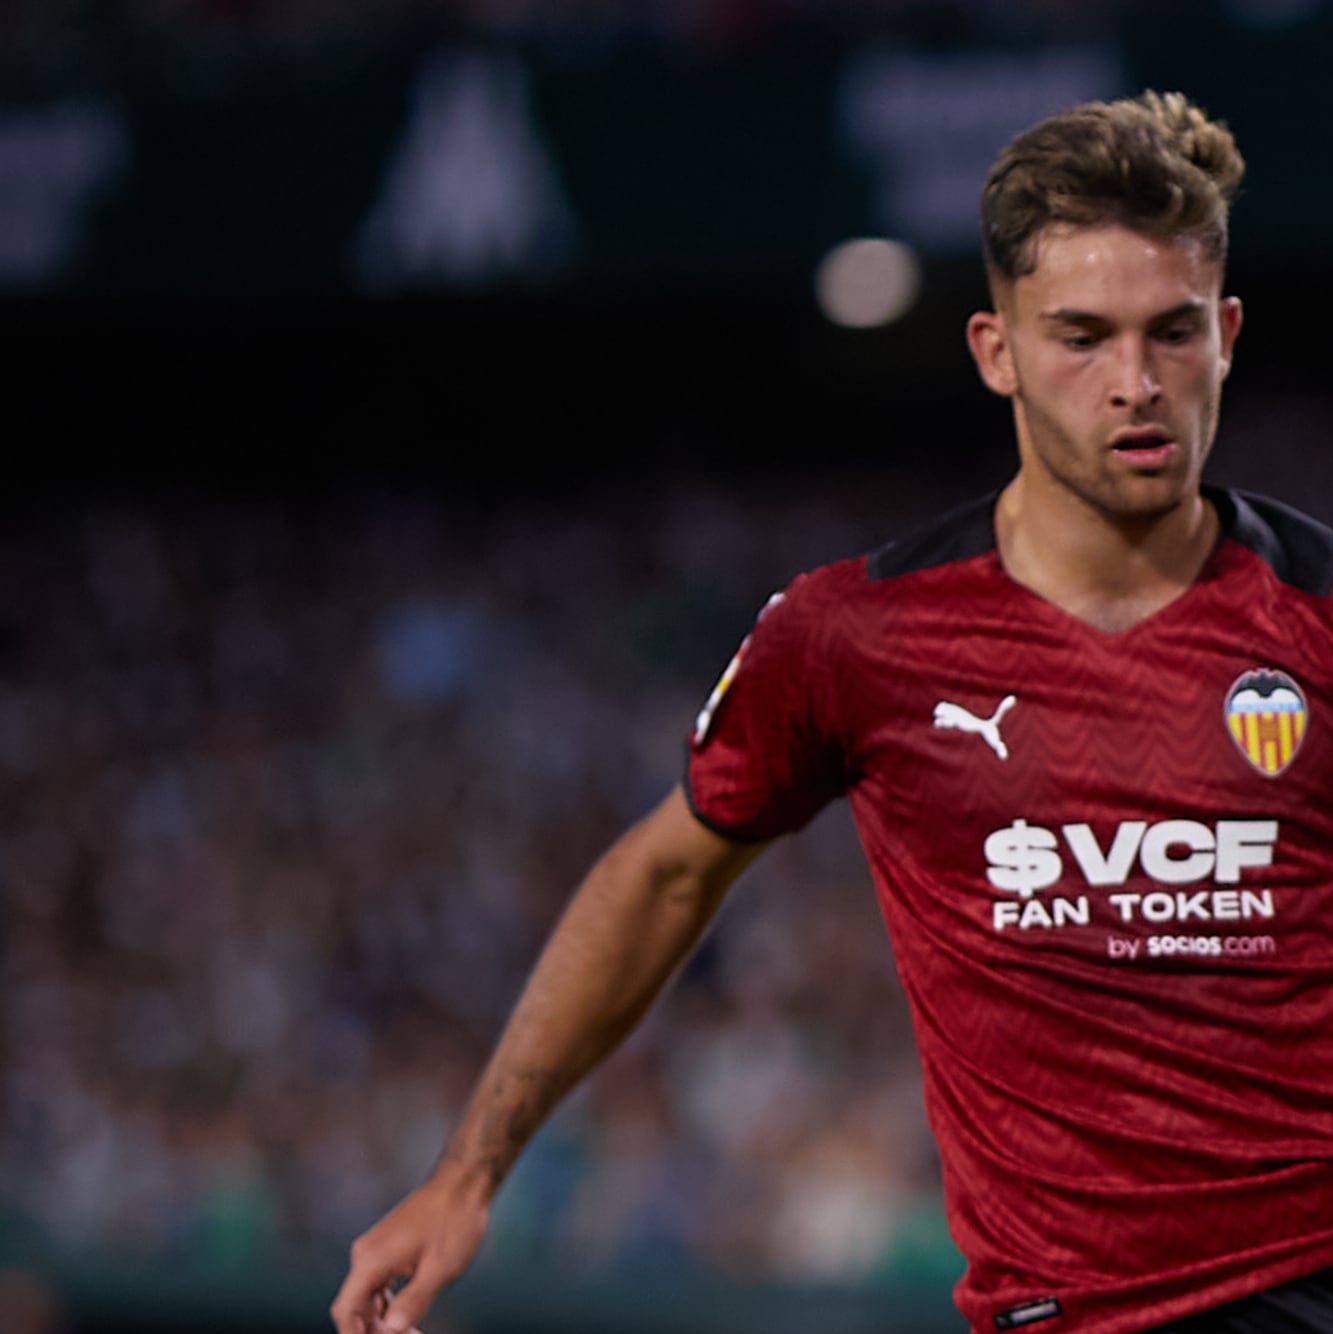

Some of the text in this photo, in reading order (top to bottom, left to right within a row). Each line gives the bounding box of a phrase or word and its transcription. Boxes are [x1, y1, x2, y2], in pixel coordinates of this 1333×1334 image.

[984, 819, 1278, 898] $VCF
[993, 889, 1275, 931] FAN TOKEN
[1108, 936, 1140, 960] by
